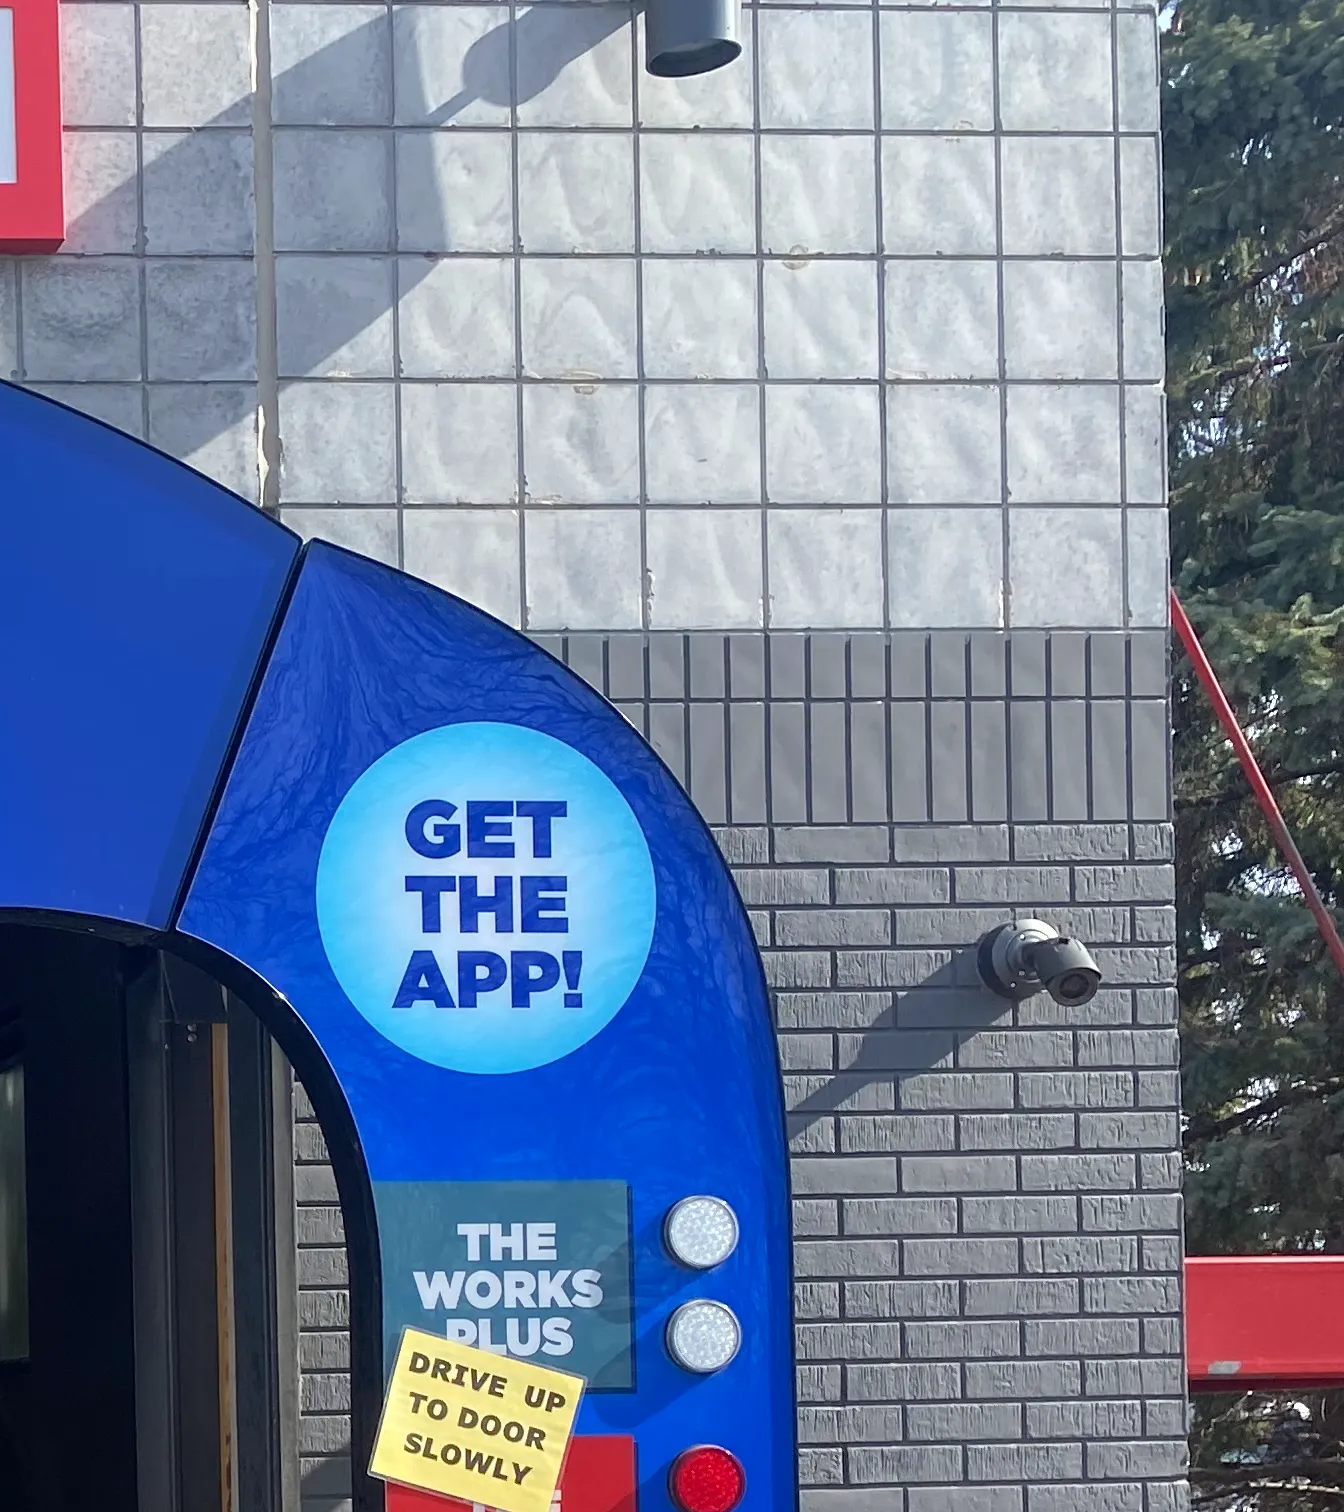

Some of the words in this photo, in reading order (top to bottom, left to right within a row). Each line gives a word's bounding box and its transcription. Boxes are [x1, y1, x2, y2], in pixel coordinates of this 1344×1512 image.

[405, 799, 567, 859] GET
[405, 876, 569, 933] THE
[392, 950, 582, 1008] APP!
[457, 1223, 557, 1261] THE
[413, 1270, 604, 1309] WORKS
[409, 1351, 507, 1398] DRIVE
[524, 1386, 566, 1413] UP
[409, 1392, 447, 1421] TO
[458, 1407, 546, 1451] DOOR
[404, 1434, 533, 1486] SLOWLY
